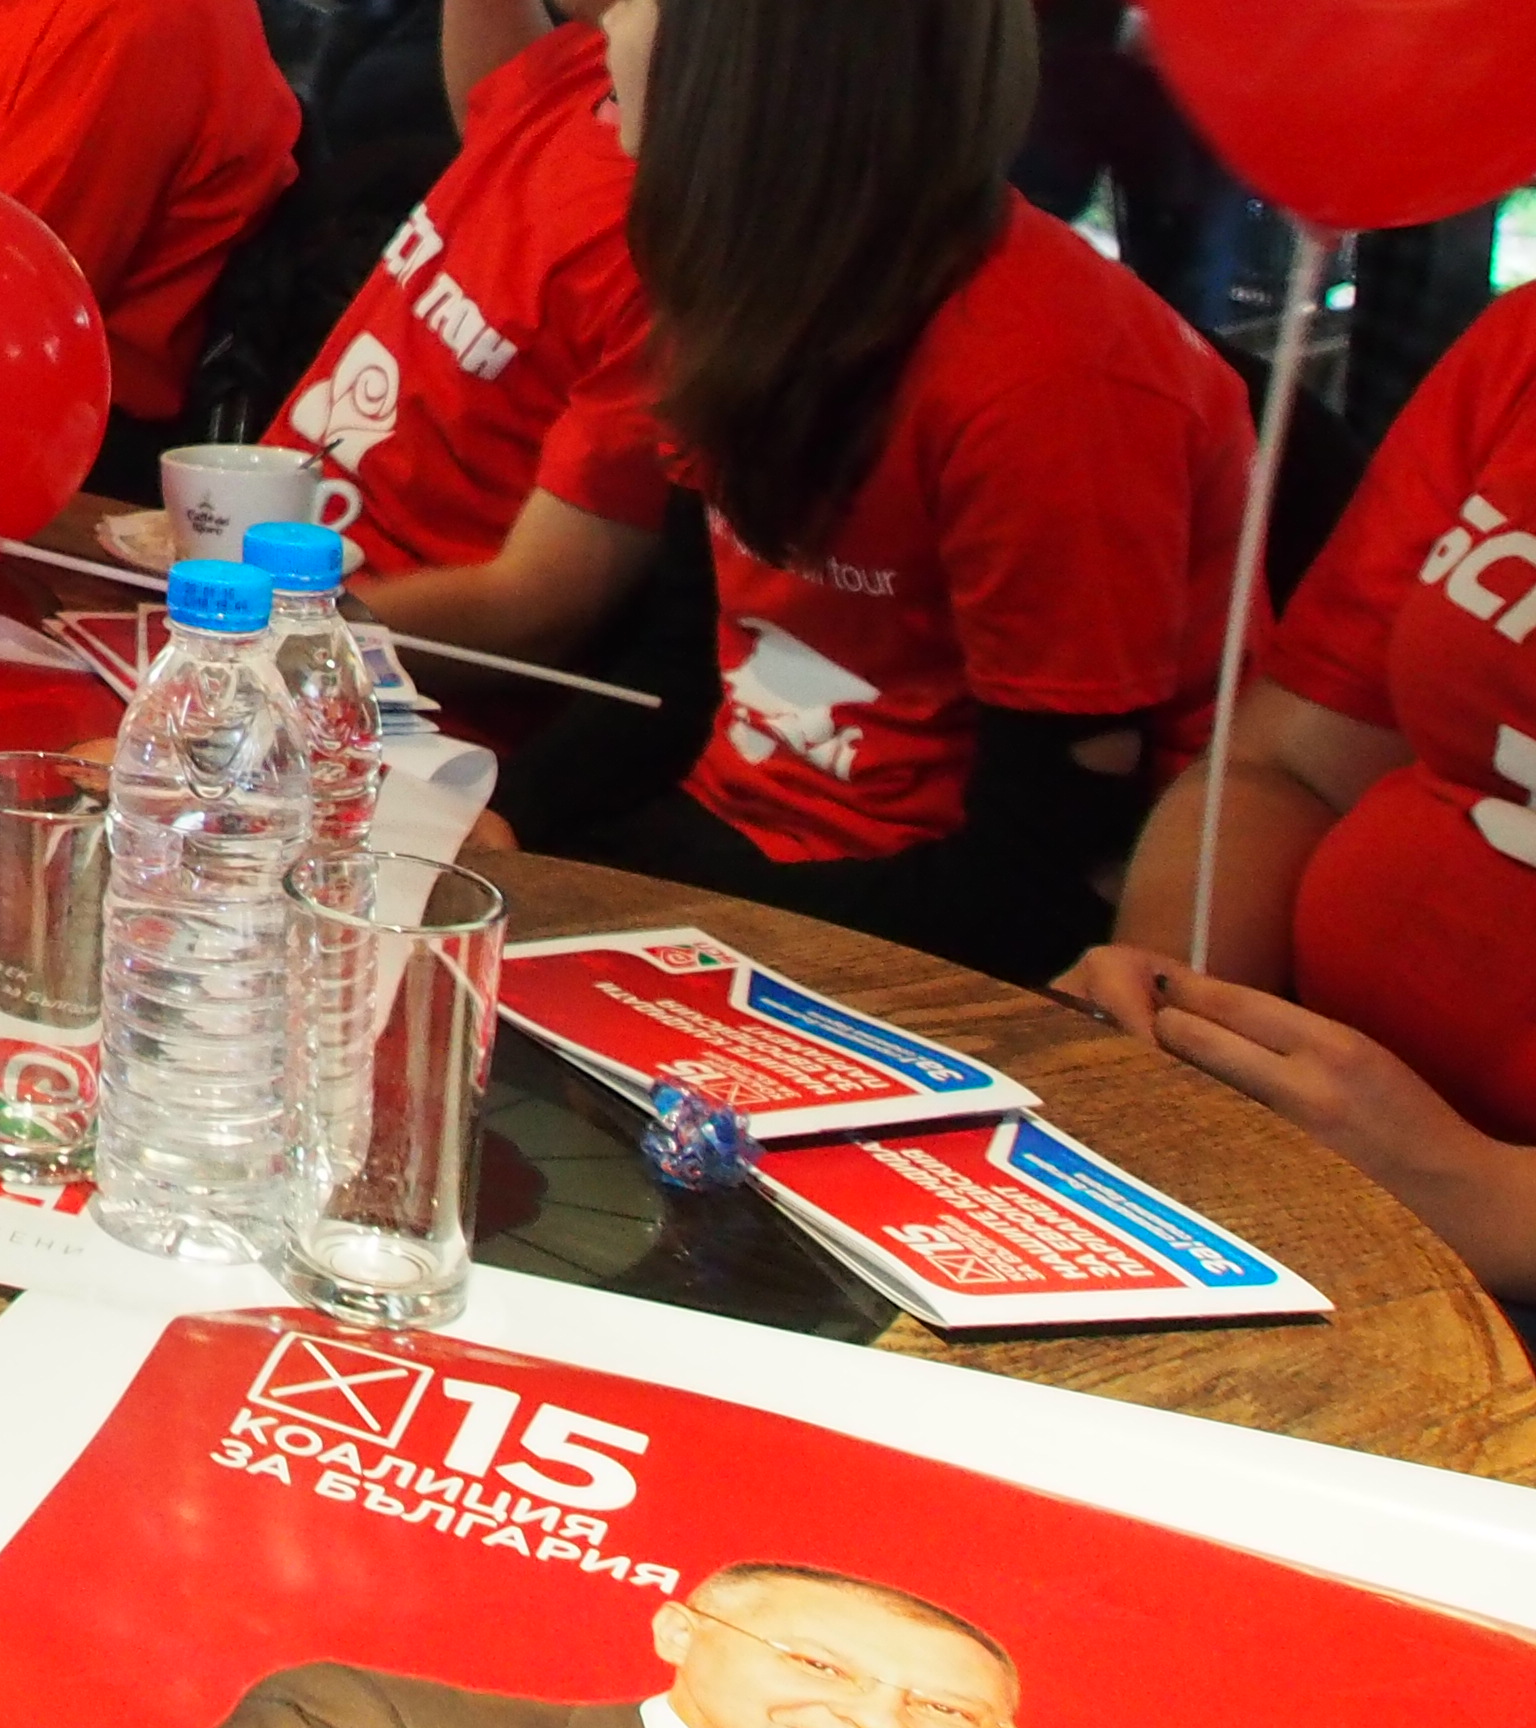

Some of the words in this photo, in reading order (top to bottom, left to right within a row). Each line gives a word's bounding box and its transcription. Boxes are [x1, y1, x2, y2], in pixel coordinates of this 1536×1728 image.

[828, 555, 896, 596] tour
[655, 1059, 730, 1086] 15
[724, 1043, 839, 1096] НАШИТЕ
[739, 1022, 892, 1090] ПАРЛАМЕНТ
[818, 1071, 865, 1093] ЗА
[895, 1055, 966, 1083] За!
[897, 1145, 1081, 1253] ЕВРОПЕЙСКИЯ
[881, 1223, 965, 1257] 15
[971, 1207, 1090, 1280] НАШИТЕ
[990, 1184, 1155, 1278] ПАРЛАМЕНТ
[1080, 1252, 1121, 1279] ЗА
[1168, 1240, 1245, 1276] За!
[441, 1377, 650, 1513] 15
[228, 1407, 609, 1548] КОАЛИЦИЯ
[209, 1436, 295, 1486] ЗА
[313, 1472, 682, 1596] БЪЛГАРИЯ
